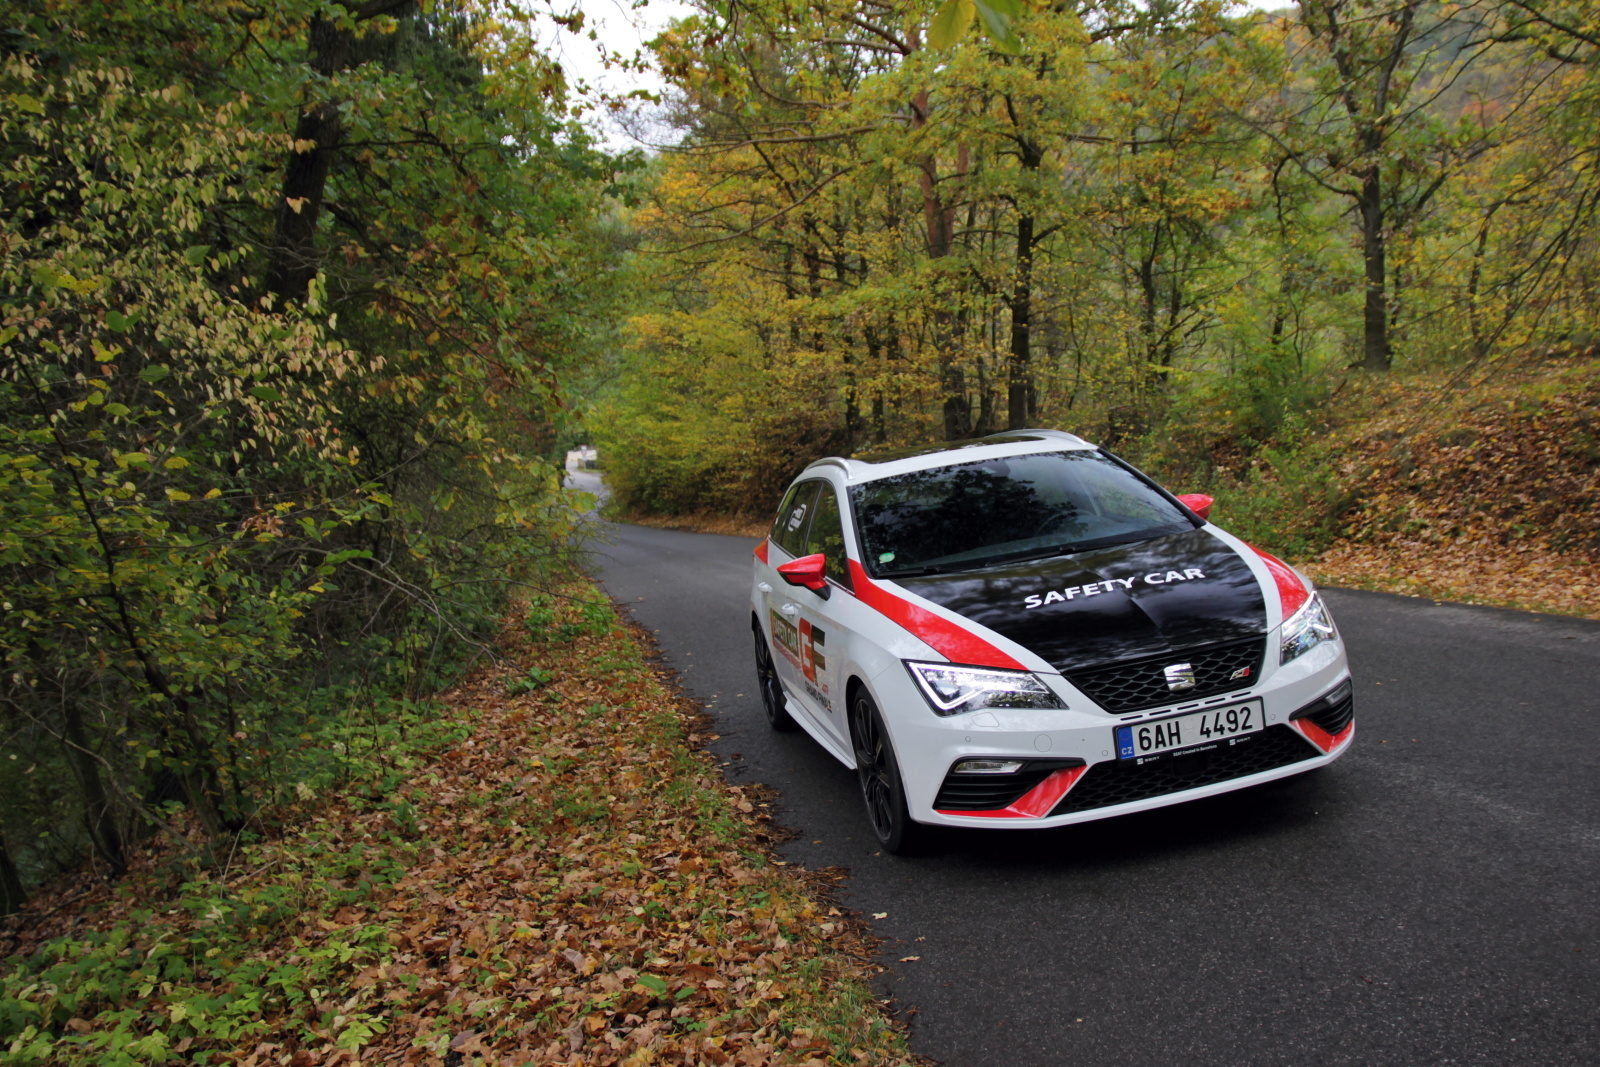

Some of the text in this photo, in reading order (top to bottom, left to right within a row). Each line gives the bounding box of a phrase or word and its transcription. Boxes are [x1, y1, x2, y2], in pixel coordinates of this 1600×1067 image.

[1024, 568, 1206, 609] SAFETY CAR
[1138, 706, 1253, 751] 6AH 4492
[1121, 746, 1133, 756] CZ
